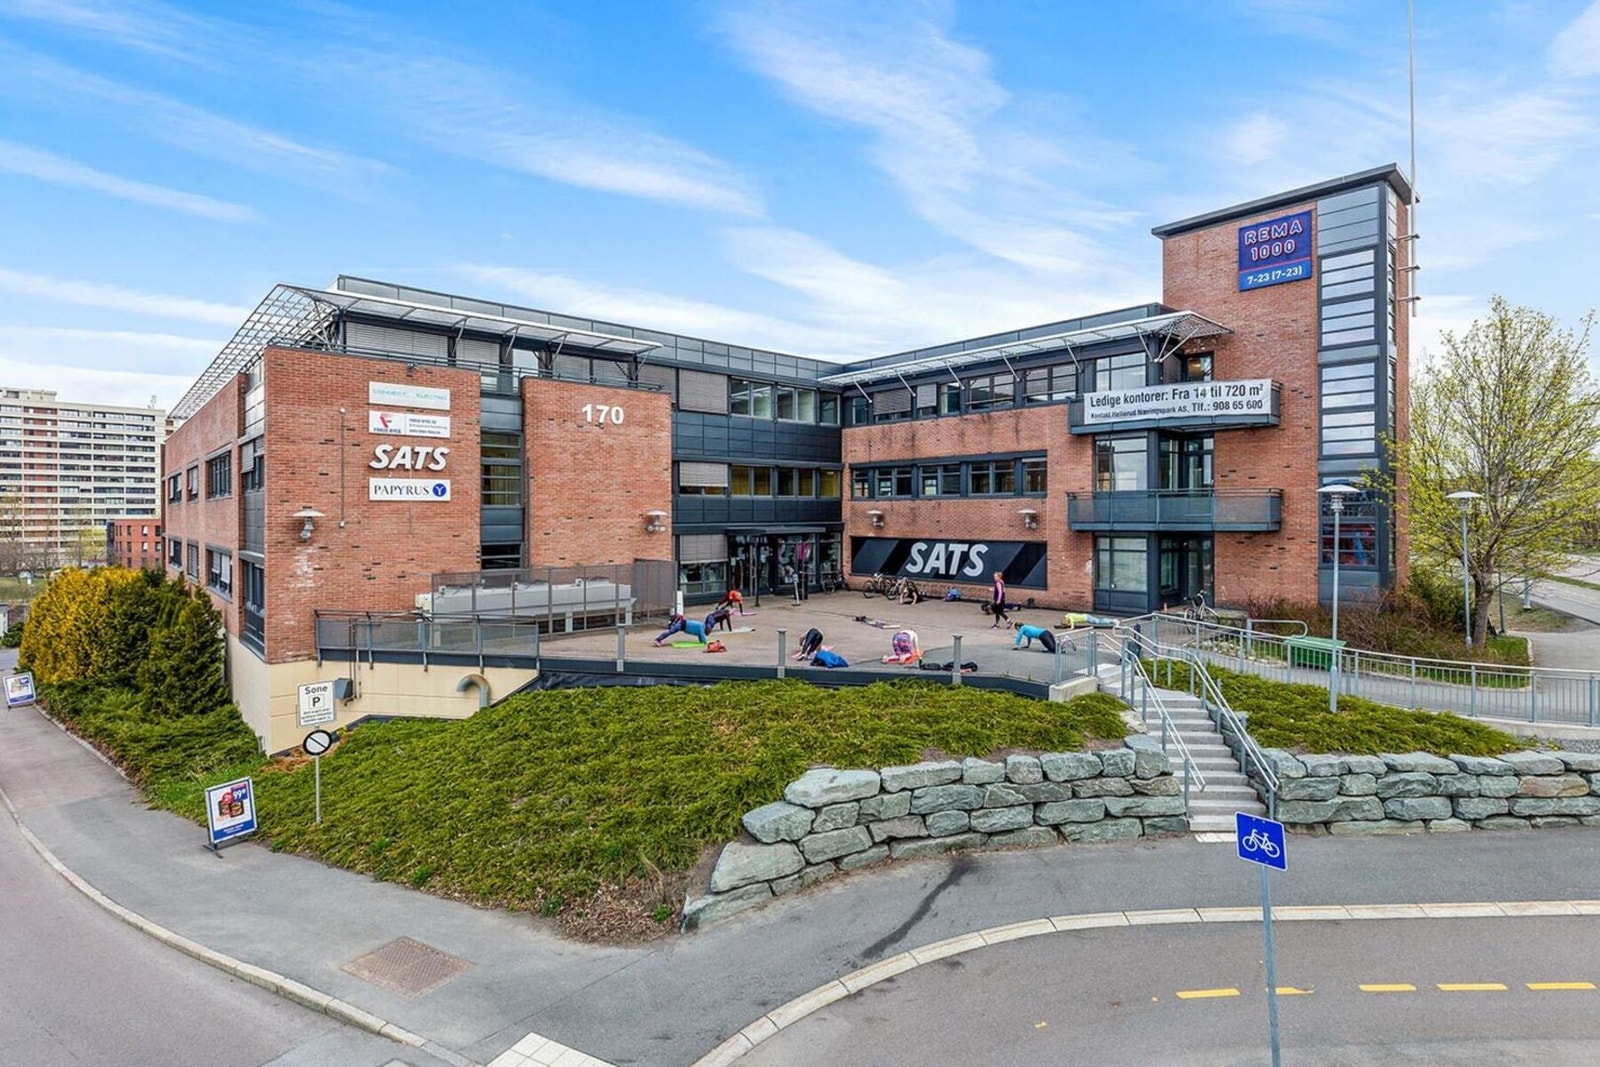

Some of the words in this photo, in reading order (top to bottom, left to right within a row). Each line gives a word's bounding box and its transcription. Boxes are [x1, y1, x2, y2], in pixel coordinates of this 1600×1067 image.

[1244, 219, 1303, 246] REMA
[1250, 239, 1295, 261] 1000
[1247, 271, 1270, 284] 7-23
[1271, 265, 1303, 280] (7-23)
[1090, 395, 1121, 408] Ledige
[1123, 391, 1169, 404] kontorer:
[1172, 388, 1190, 400] Fra
[1194, 386, 1207, 399] 14
[1210, 385, 1222, 398] til
[1225, 384, 1246, 397] 720
[1212, 401, 1231, 411] 908
[1232, 400, 1244, 410] 65
[1246, 399, 1263, 410] 600
[581, 403, 625, 425] 170
[369, 444, 450, 471] SATS
[374, 485, 430, 496] PAPYRUS
[905, 541, 989, 577] SATS
[304, 685, 328, 695] Sone
[312, 696, 321, 707] P
